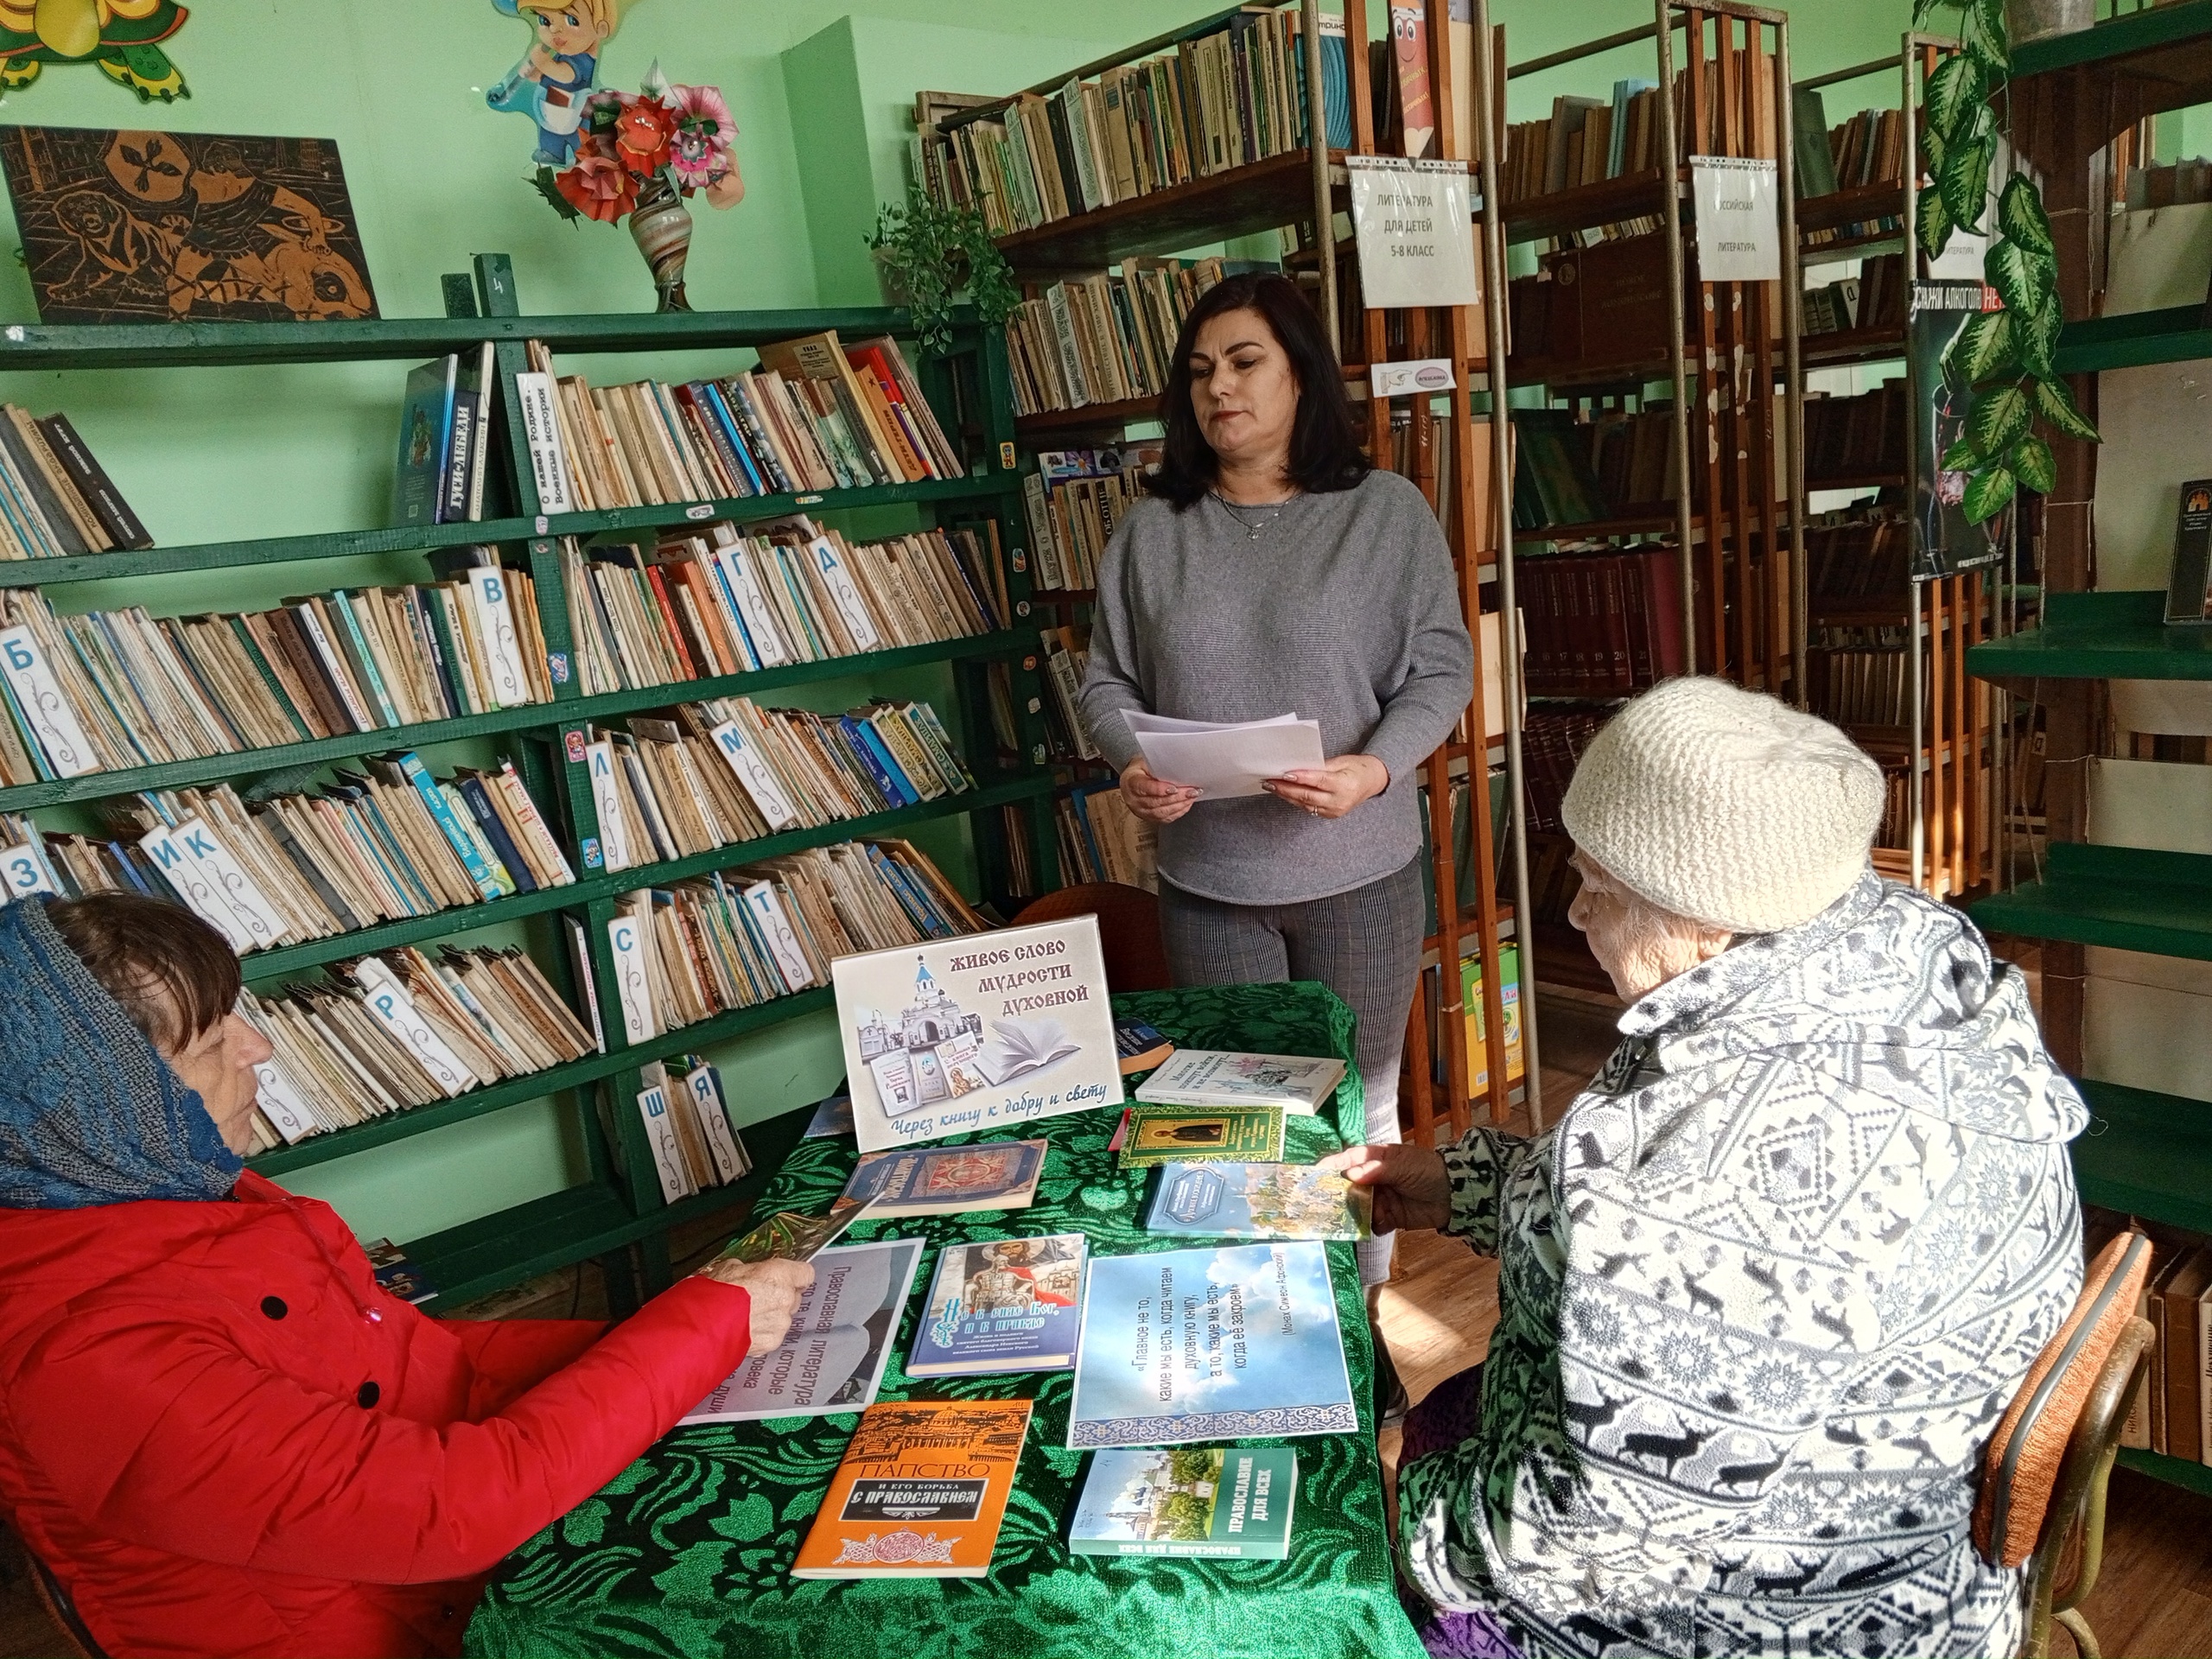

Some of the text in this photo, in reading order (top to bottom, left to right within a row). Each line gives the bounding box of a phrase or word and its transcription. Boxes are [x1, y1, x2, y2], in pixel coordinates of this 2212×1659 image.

[1377, 194, 1433, 207] ЛИТЕРАТУРА
[1384, 217, 1433, 234] ДЛЯ ДЕТЕЙ
[1390, 245, 1434, 257] 5-8 КЛАСС
[1718, 242, 1756, 252] ЛИТЕРАТУРА
[1945, 246, 1974, 256] ИТЕРАТУРА
[1916, 286, 2006, 310] СКАЖИ АЛКОГОЛЮ НЕ
[524, 389, 550, 505] О нашей Родине.
[537, 387, 564, 505] Военные истории
[883, 409, 918, 472] ДЕТИ-ГЕРОИ
[450, 404, 471, 510] ГУСИ-ЛЕБЕДИ
[729, 551, 743, 577] Г
[817, 546, 838, 574] Д
[482, 577, 503, 604] В
[2, 638, 35, 671] Б
[1559, 652, 1567, 660] 17
[1594, 652, 1604, 661] 19
[1614, 652, 1625, 660] 20
[720, 727, 747, 755] М
[595, 752, 609, 777] Л
[150, 838, 182, 870] И
[183, 828, 218, 861] К
[10, 858, 39, 889] З
[753, 890, 772, 913] Т
[615, 927, 633, 952] С
[950, 939, 1066, 972] ЖИВОЕ СЛОВО
[978, 963, 1073, 995] МУДРОСТИ
[374, 995, 396, 1021] Р
[1002, 984, 1090, 1017] ДУХОВНОЙ
[1168, 1061, 1198, 1081] Многие
[692, 1076, 713, 1102] Я
[645, 1091, 666, 1118] Ш
[891, 1084, 1108, 1140] Через книгу к добру и свету
[815, 1266, 852, 1334] Православная
[1206, 1282, 1220, 1306] есть,
[1273, 1252, 1296, 1337] (Монах Симеон Афонский)
[1029, 1302, 1060, 1317] Бог,
[1208, 1306, 1219, 1322] мы
[782, 1317, 806, 1347] книги,
[1131, 1296, 1152, 1372] «Главное не то,
[1160, 1267, 1175, 1402] какие мы есть, когда читаем
[1184, 1294, 1198, 1370] духовную книгу,
[1208, 1323, 1221, 1351] какие
[1230, 1283, 1249, 1370] когда её закроем»
[768, 1348, 797, 1395] которые
[794, 1339, 827, 1406] литература
[1210, 1352, 1224, 1368] то,
[859, 1463, 991, 1478] ПАПСТВО
[850, 1491, 979, 1503] С ПРАВОСЛАВИЕМ
[1228, 1457, 1253, 1533] ПРАВОСЛАВИЕ
[1251, 1469, 1272, 1521] ДЛЯ ВСЕХ
[1118, 1544, 1242, 1555] ПРАВОСЛАВИЕ ДЛЯ ВСЕХ
